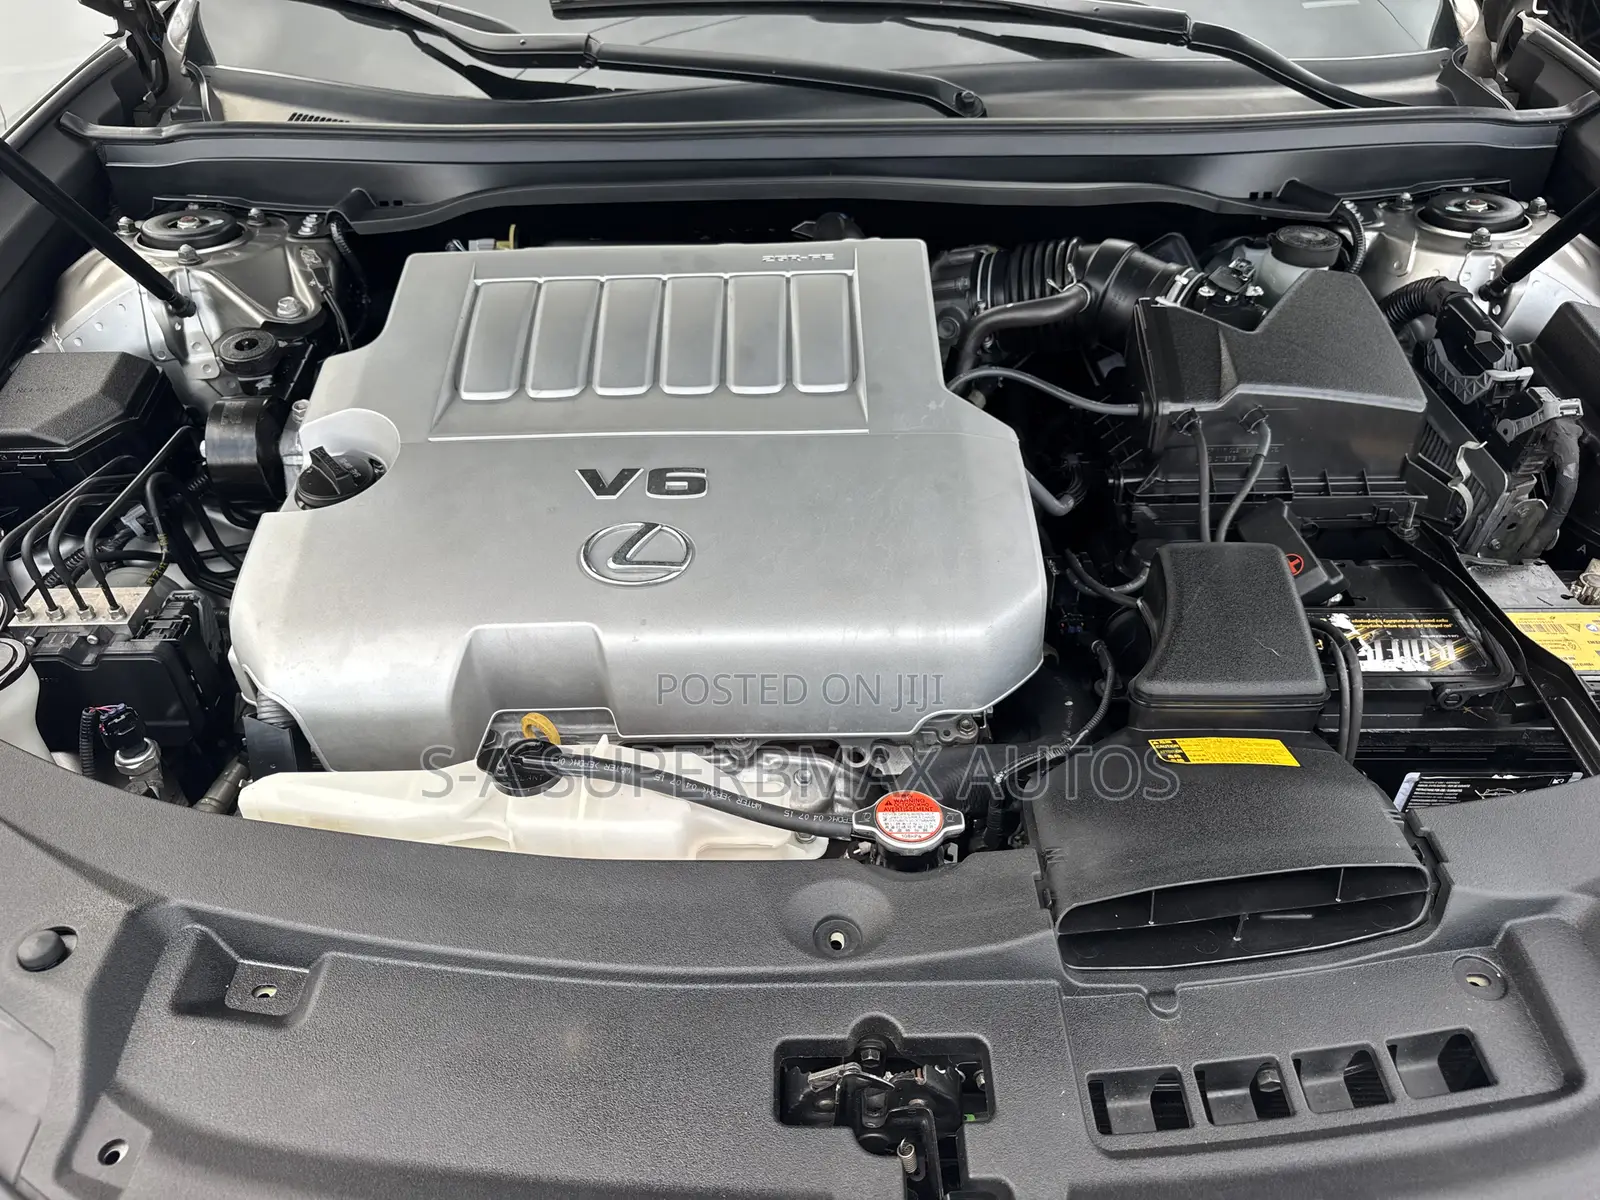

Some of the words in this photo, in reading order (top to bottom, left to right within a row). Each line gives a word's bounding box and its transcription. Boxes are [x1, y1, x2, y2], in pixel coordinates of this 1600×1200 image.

[575, 467, 707, 500] V6
[736, 797, 762, 811] WATER
[783, 810, 794, 818] 15
[798, 813, 810, 821] 07
[813, 814, 824, 822] 04
